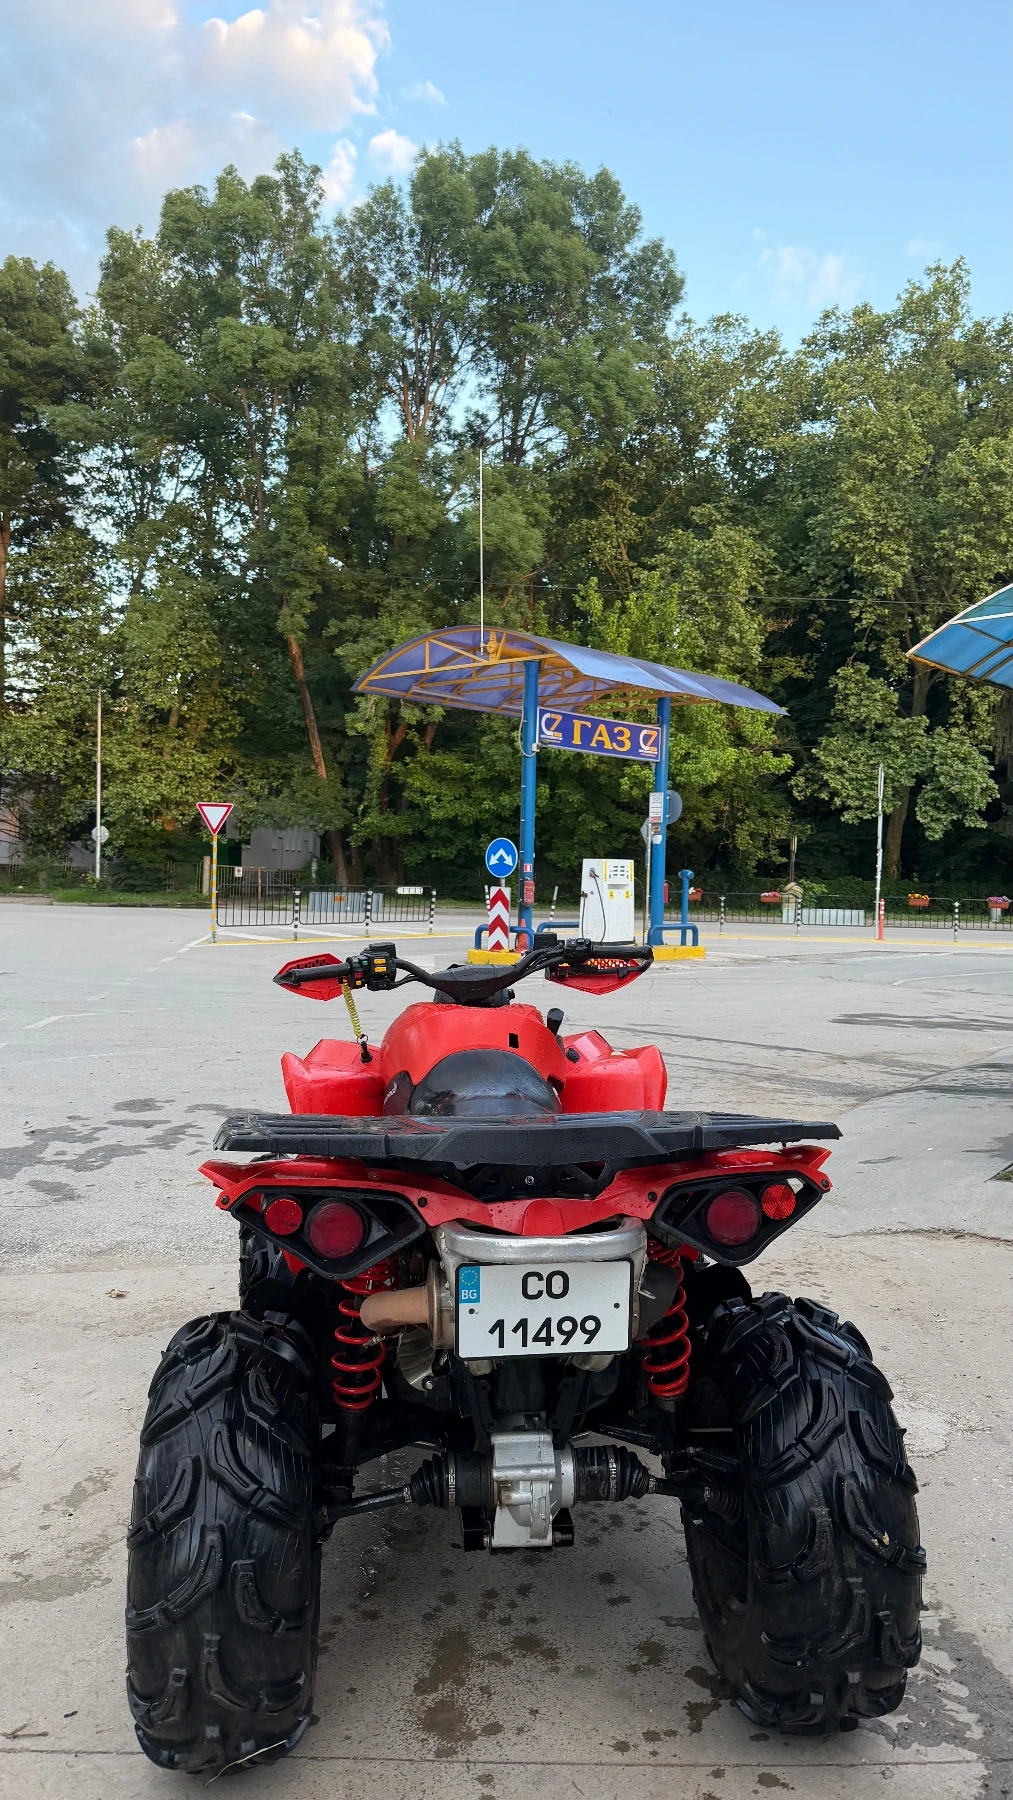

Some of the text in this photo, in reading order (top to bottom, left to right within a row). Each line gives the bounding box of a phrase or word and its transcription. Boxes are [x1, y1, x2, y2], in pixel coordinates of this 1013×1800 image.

[572, 719, 632, 752] ГАЗ
[461, 1290, 477, 1300] BG
[521, 1270, 570, 1300] CO
[488, 1314, 602, 1349] 11499
